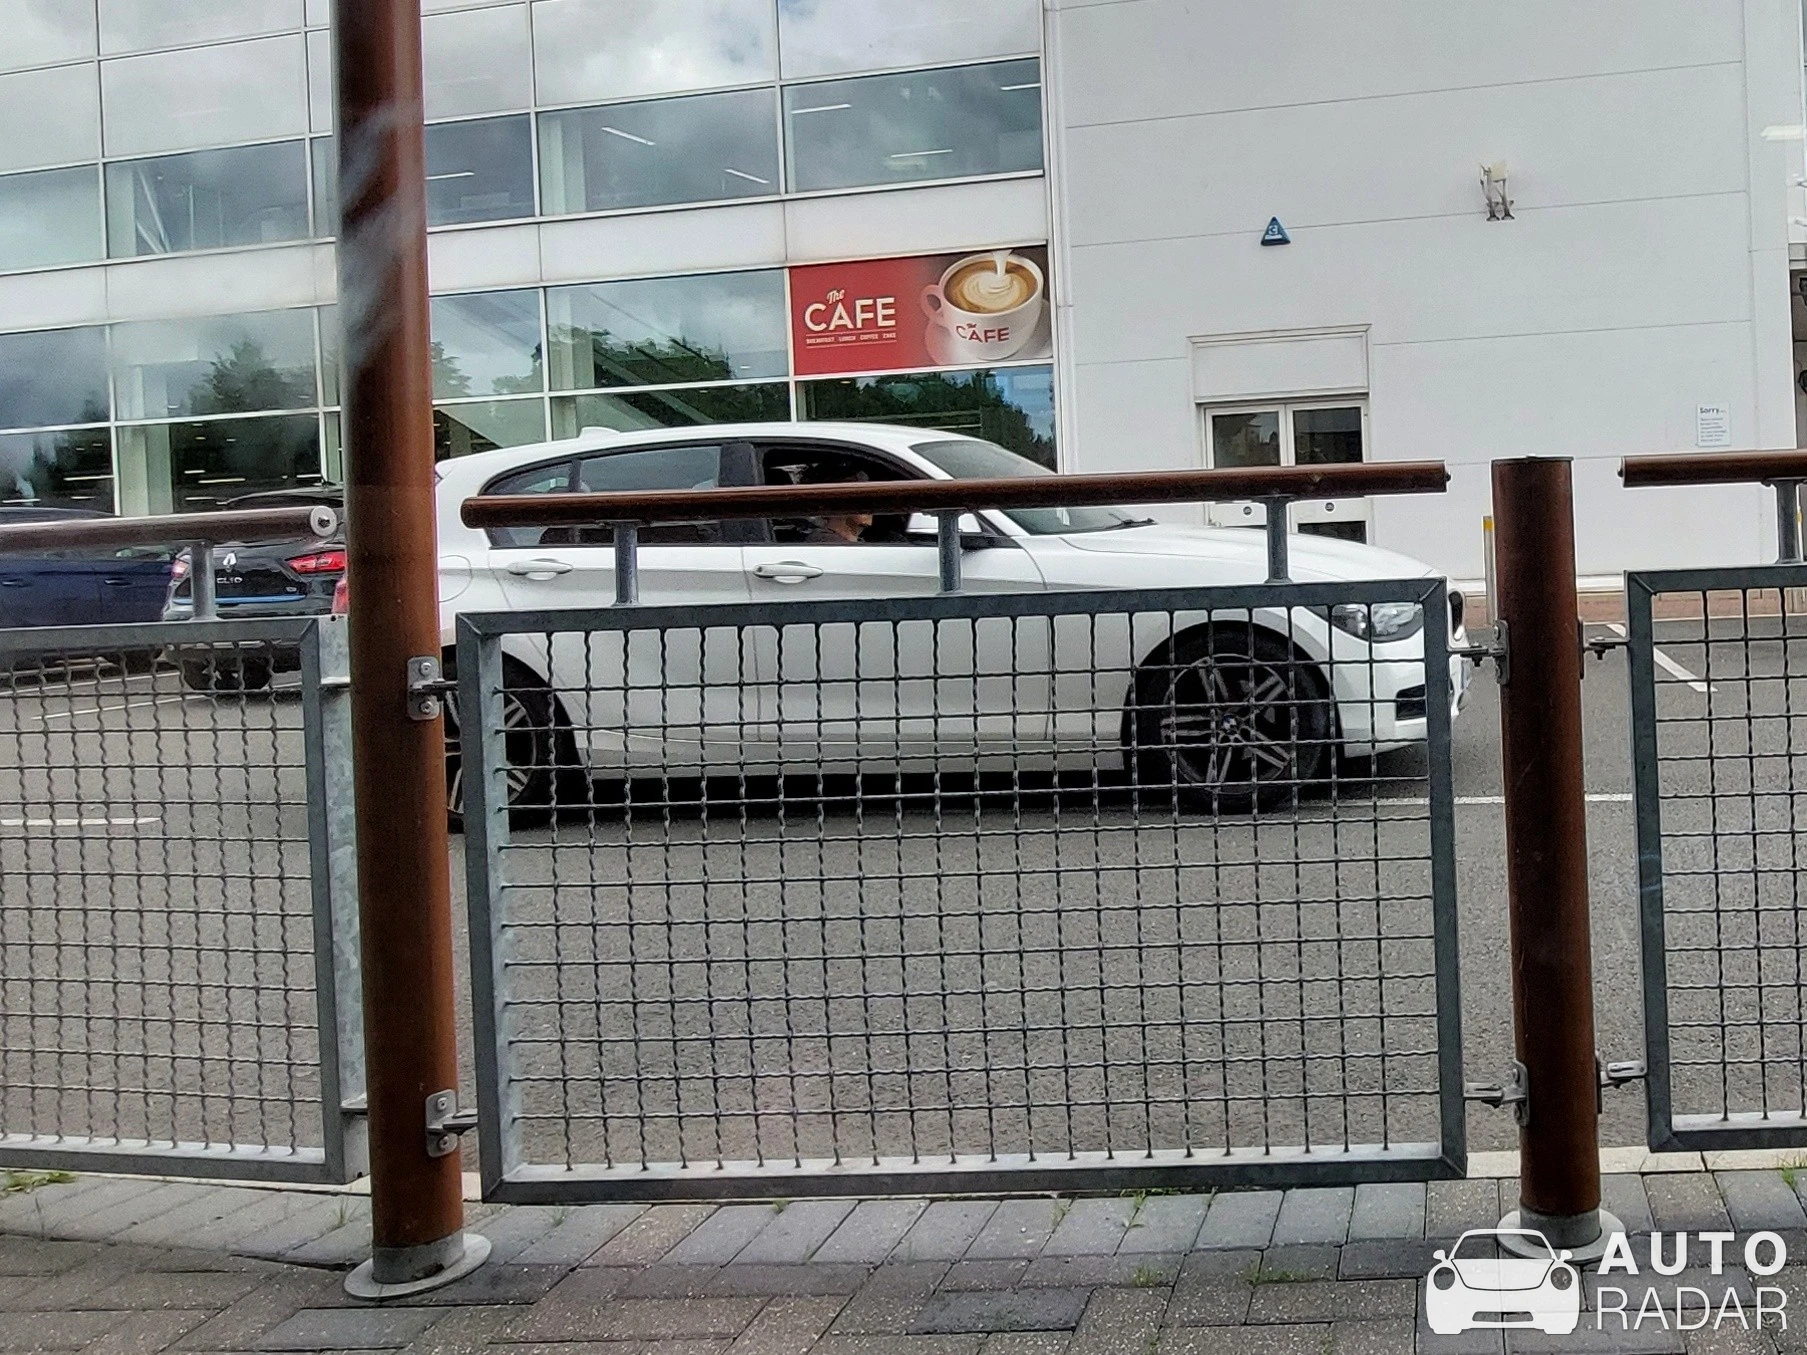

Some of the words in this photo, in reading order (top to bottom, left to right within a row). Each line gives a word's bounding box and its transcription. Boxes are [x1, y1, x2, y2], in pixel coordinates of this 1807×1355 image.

[827, 289, 845, 304] The
[804, 297, 896, 332] CAFE
[956, 326, 1010, 343] CAFE
